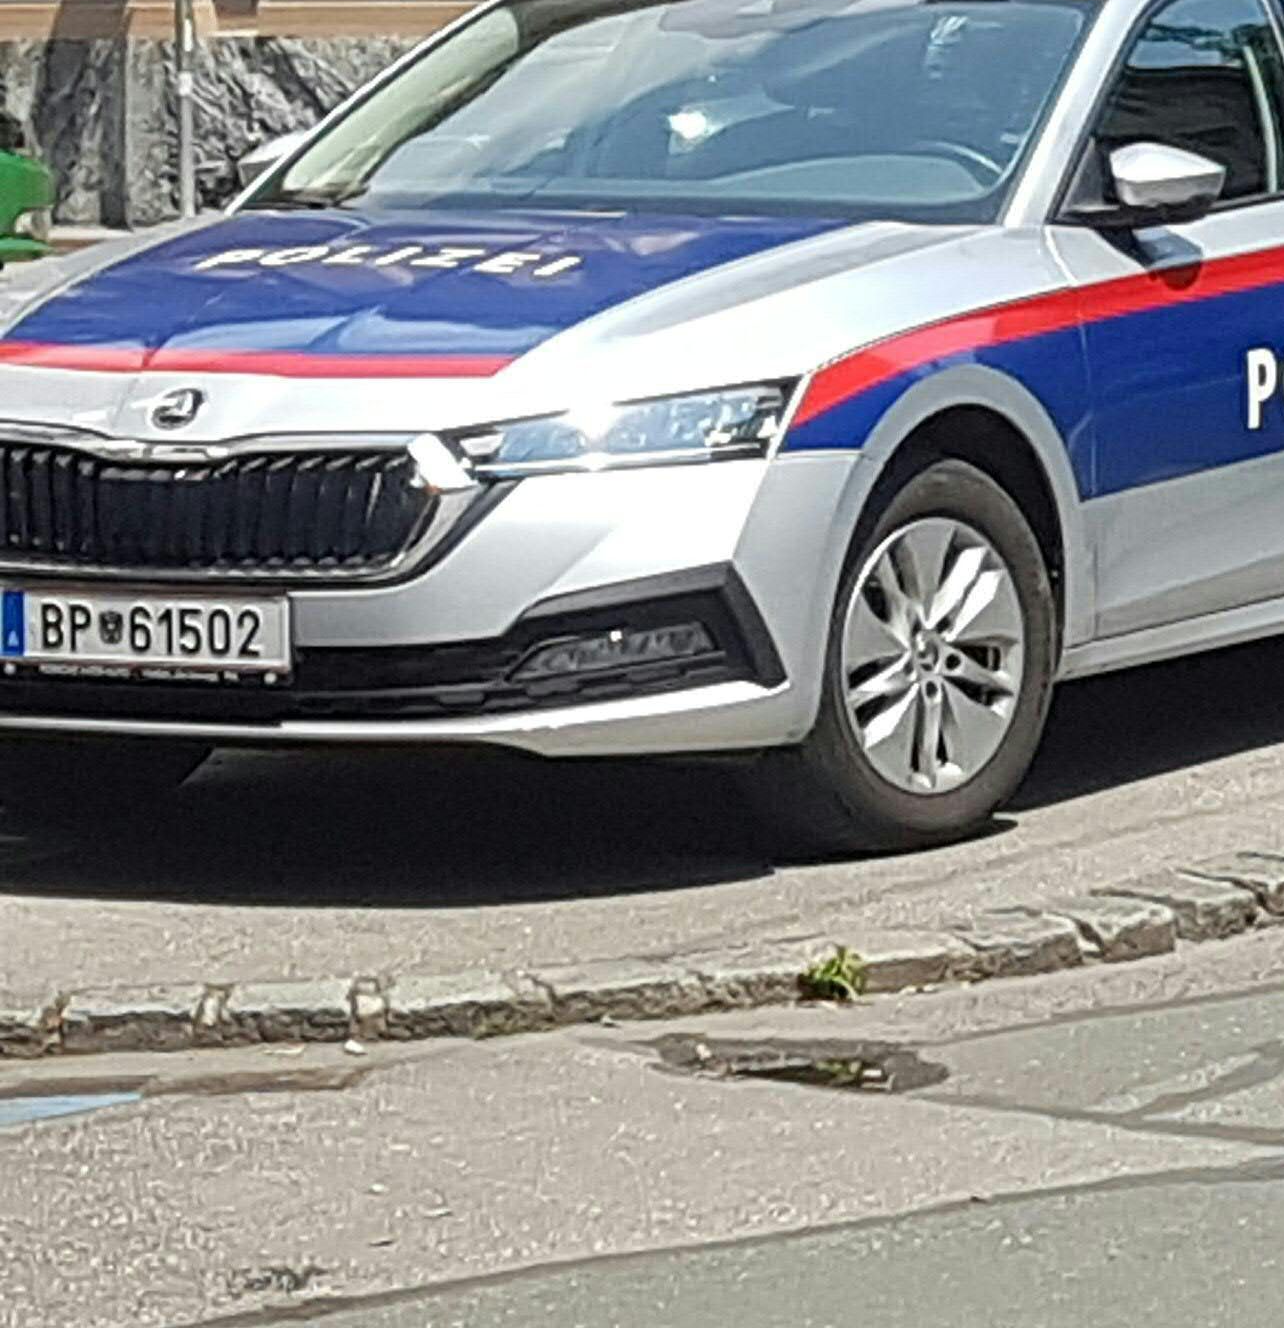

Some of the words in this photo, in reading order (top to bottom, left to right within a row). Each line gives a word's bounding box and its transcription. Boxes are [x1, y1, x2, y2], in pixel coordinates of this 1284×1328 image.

[193, 245, 581, 276] POLIZEI
[41, 602, 92, 652] BP
[129, 606, 260, 656] 61502
